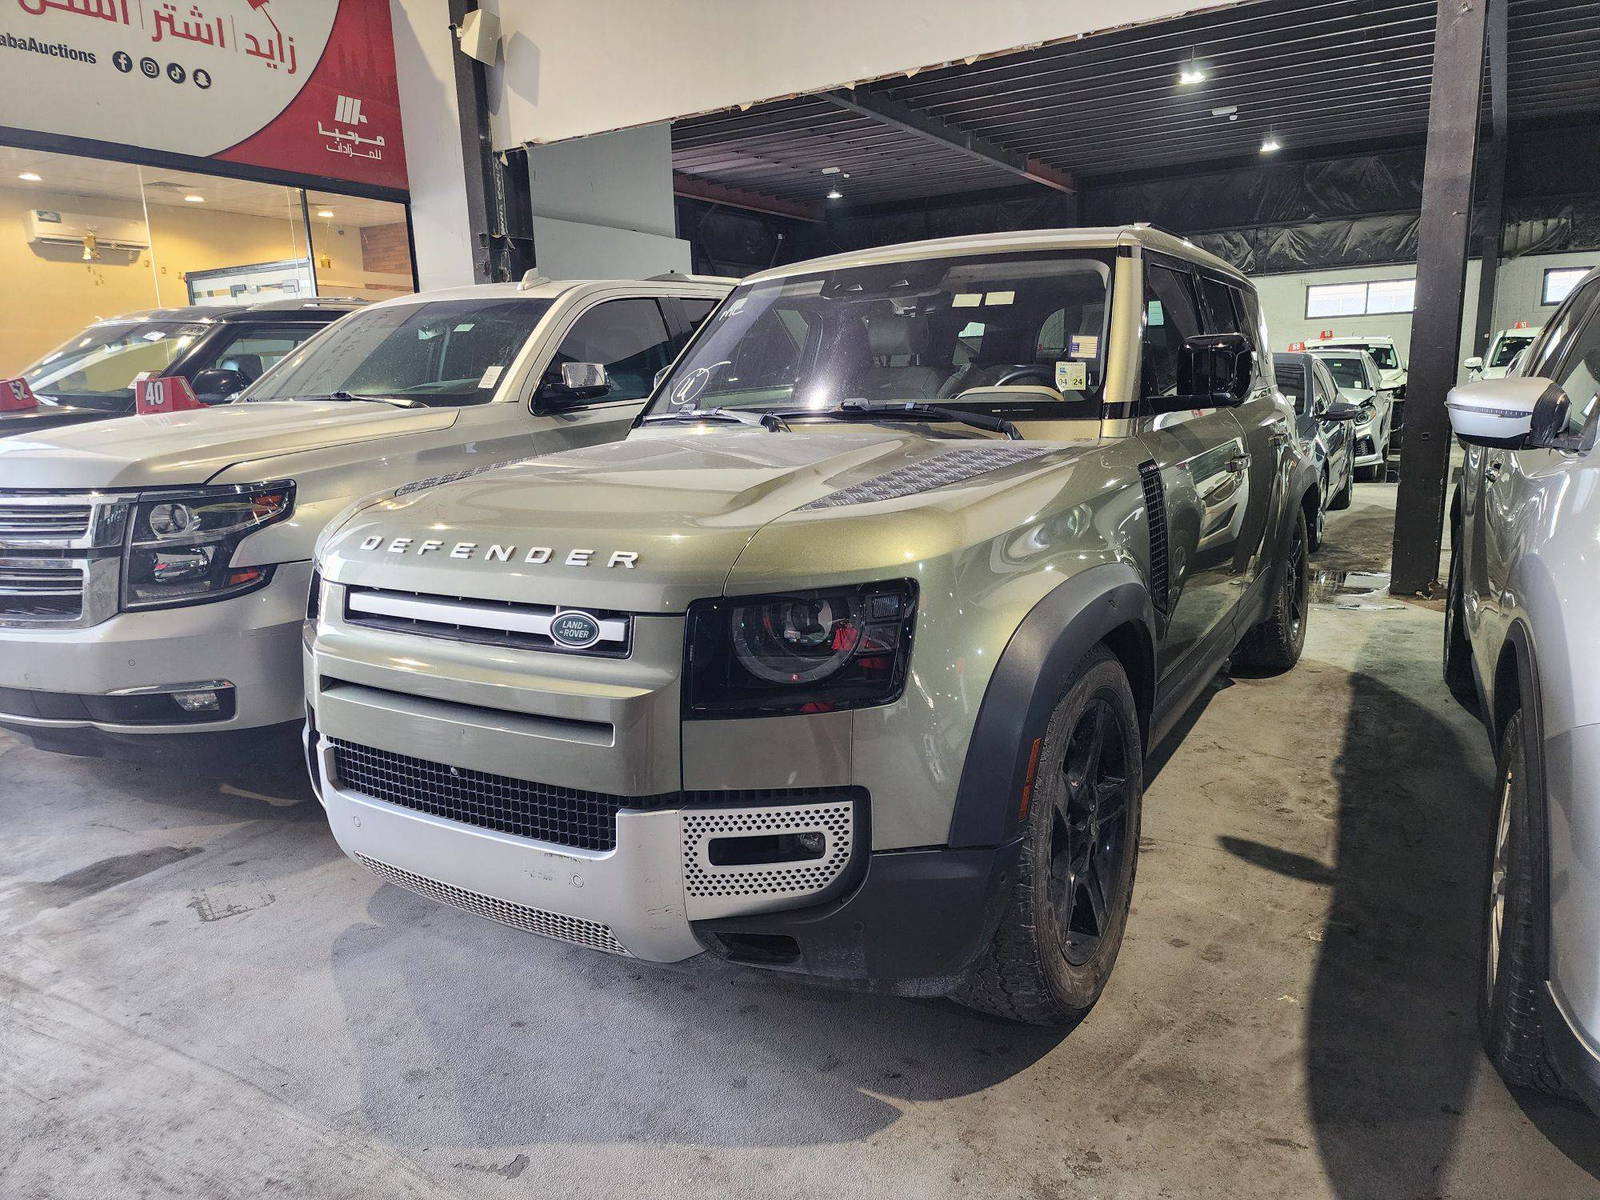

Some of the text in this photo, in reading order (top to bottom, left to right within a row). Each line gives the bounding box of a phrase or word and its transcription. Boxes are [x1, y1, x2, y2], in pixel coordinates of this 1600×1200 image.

[152, 4, 225, 48] اشتر
[245, 32, 297, 74] زايد
[9, 381, 29, 401] 52
[145, 381, 164, 406] 40
[1073, 378, 1083, 386] 24
[360, 535, 640, 569] DEFENDER
